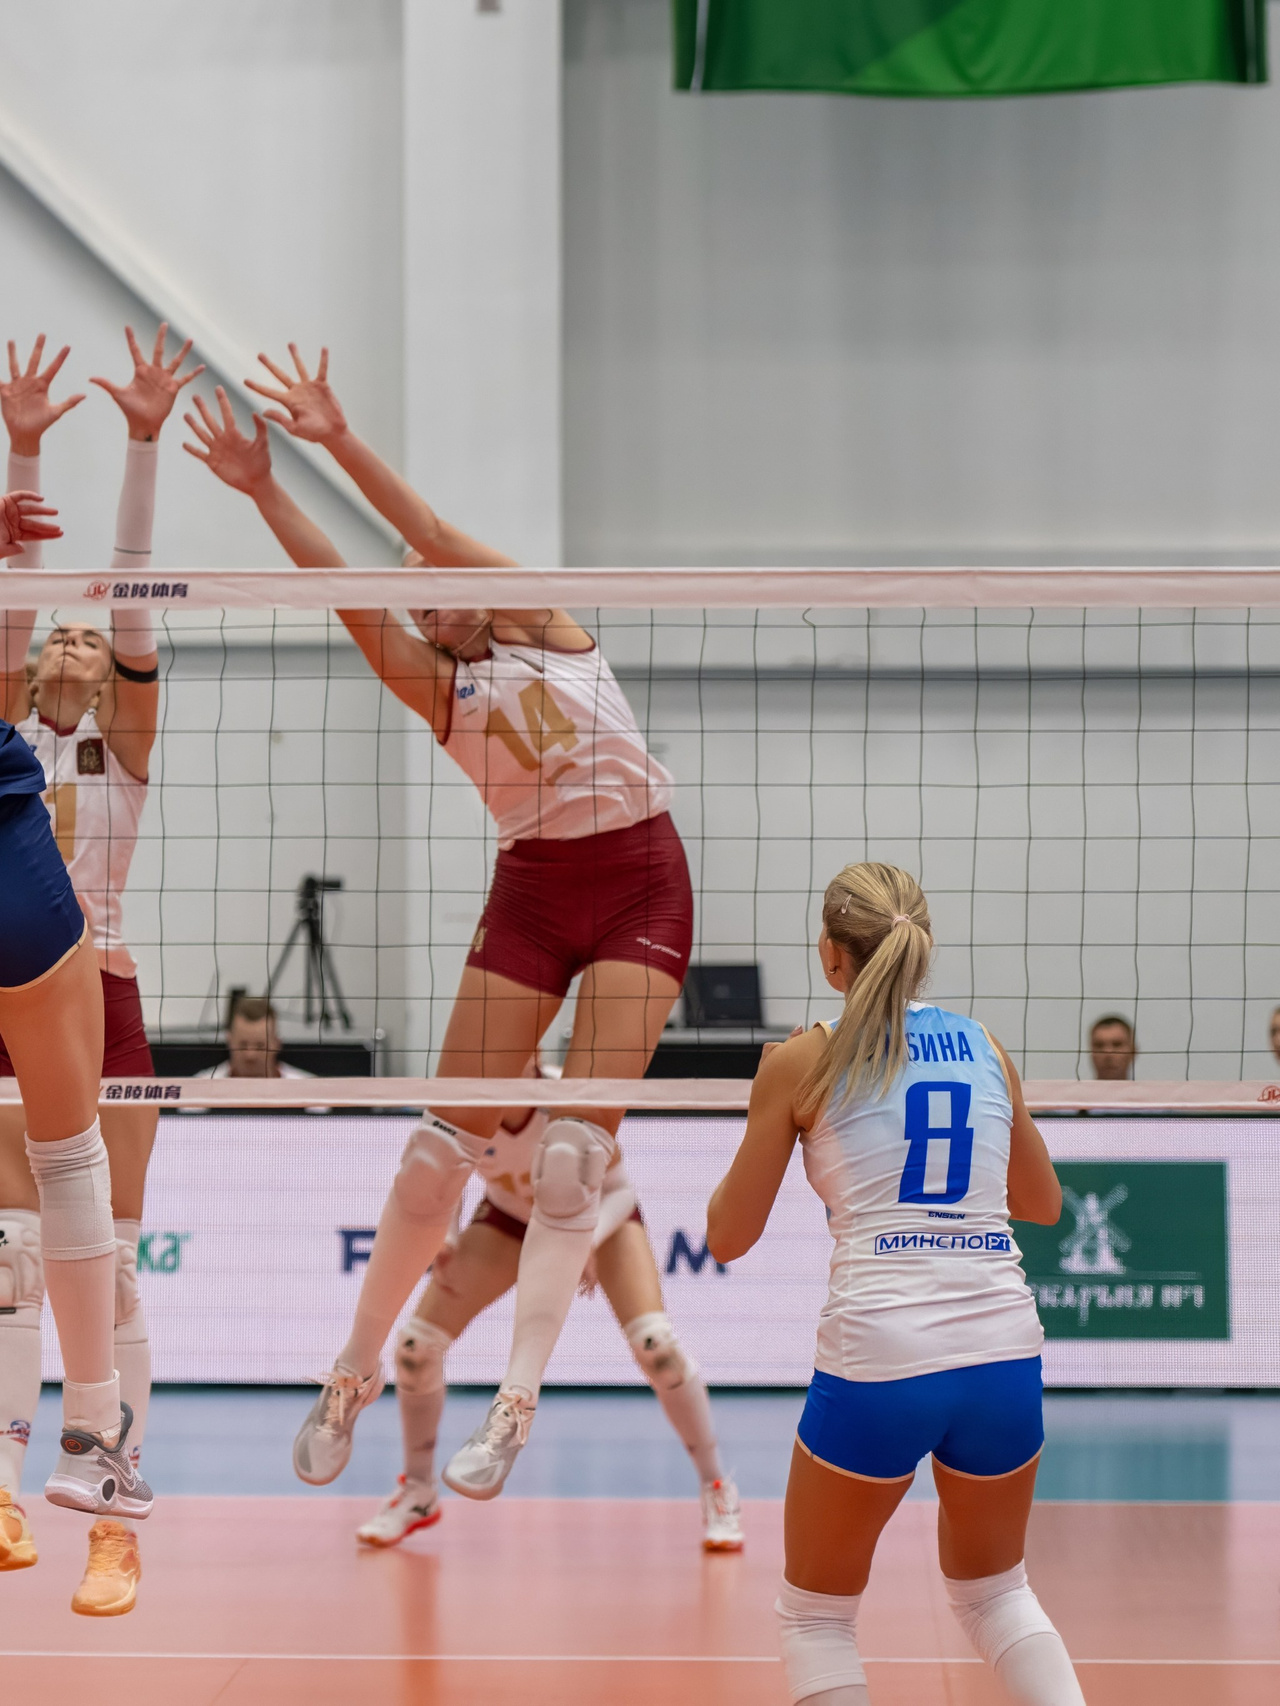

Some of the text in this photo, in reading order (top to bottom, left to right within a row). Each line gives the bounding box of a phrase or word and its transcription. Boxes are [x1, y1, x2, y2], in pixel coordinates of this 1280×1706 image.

[112, 582, 188, 598] 金陵体育
[482, 680, 580, 772] 14
[905, 1031, 975, 1062] БИНА
[106, 1085, 182, 1100] 金陵体育
[897, 1081, 974, 1204] 8
[928, 1211, 966, 1220] ENSEN
[879, 1234, 1010, 1251] МИНСПОРТ
